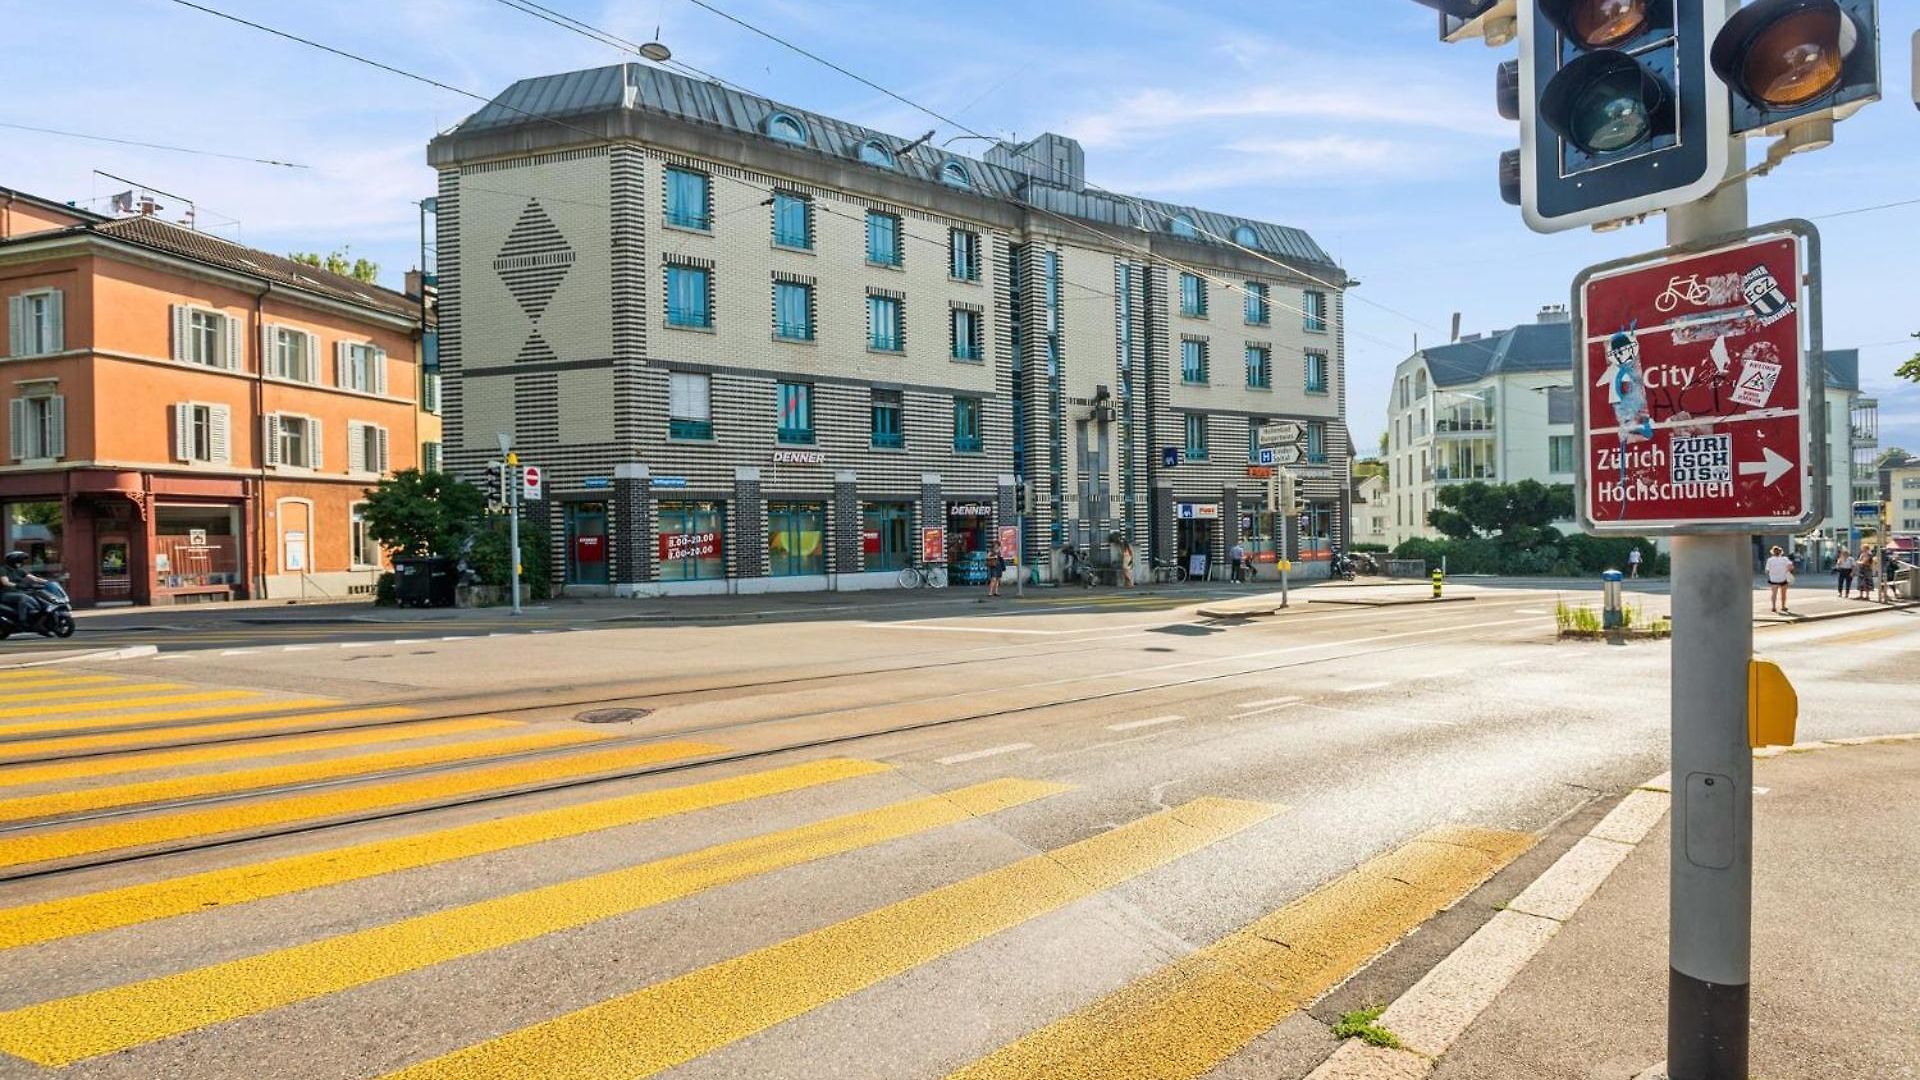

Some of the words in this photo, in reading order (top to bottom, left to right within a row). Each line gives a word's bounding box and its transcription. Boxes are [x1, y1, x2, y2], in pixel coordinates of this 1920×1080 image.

[1746, 278, 1774, 301] FCZ
[1643, 364, 1695, 390] City
[1673, 434, 1728, 454] ZÜRI
[773, 451, 825, 464] DENNER
[1597, 444, 1665, 470] Zürich
[1673, 452, 1729, 469] ISCH
[1673, 467, 1712, 482] OIS
[1598, 479, 1734, 502] Hochschulen
[951, 505, 991, 516] DENNER
